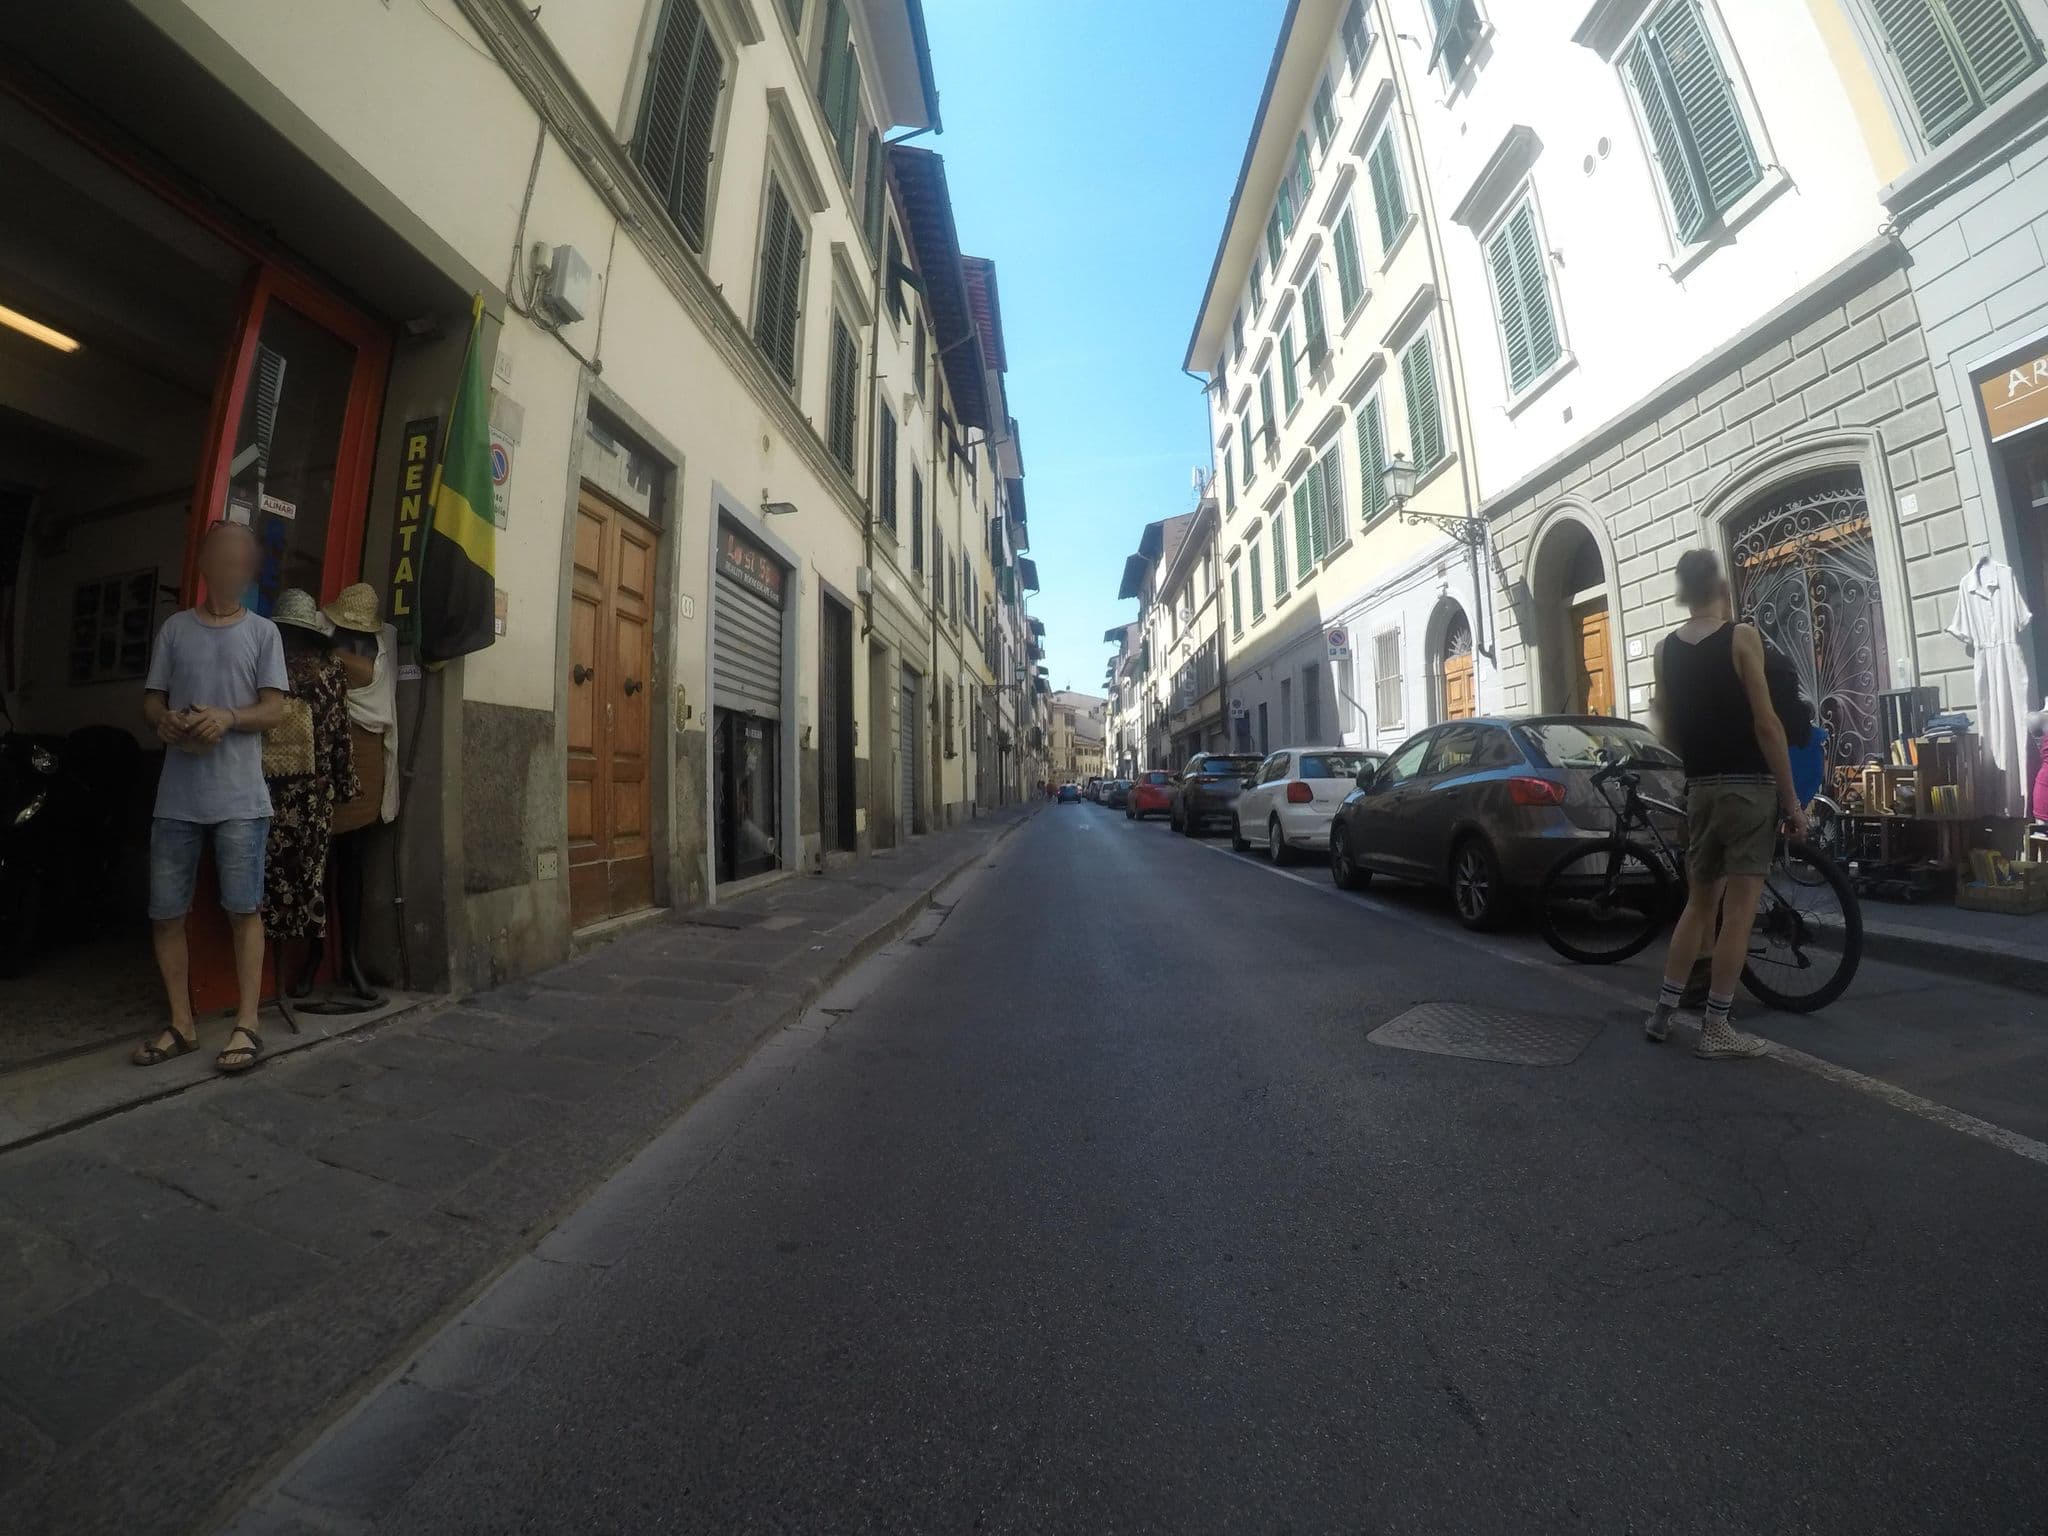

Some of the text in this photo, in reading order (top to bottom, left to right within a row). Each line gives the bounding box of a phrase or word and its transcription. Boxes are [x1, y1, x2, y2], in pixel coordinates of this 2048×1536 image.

[263, 499, 294, 515] ALINARI
[394, 435, 428, 616] RENTAL
[1179, 608, 1196, 708] GARAGE
